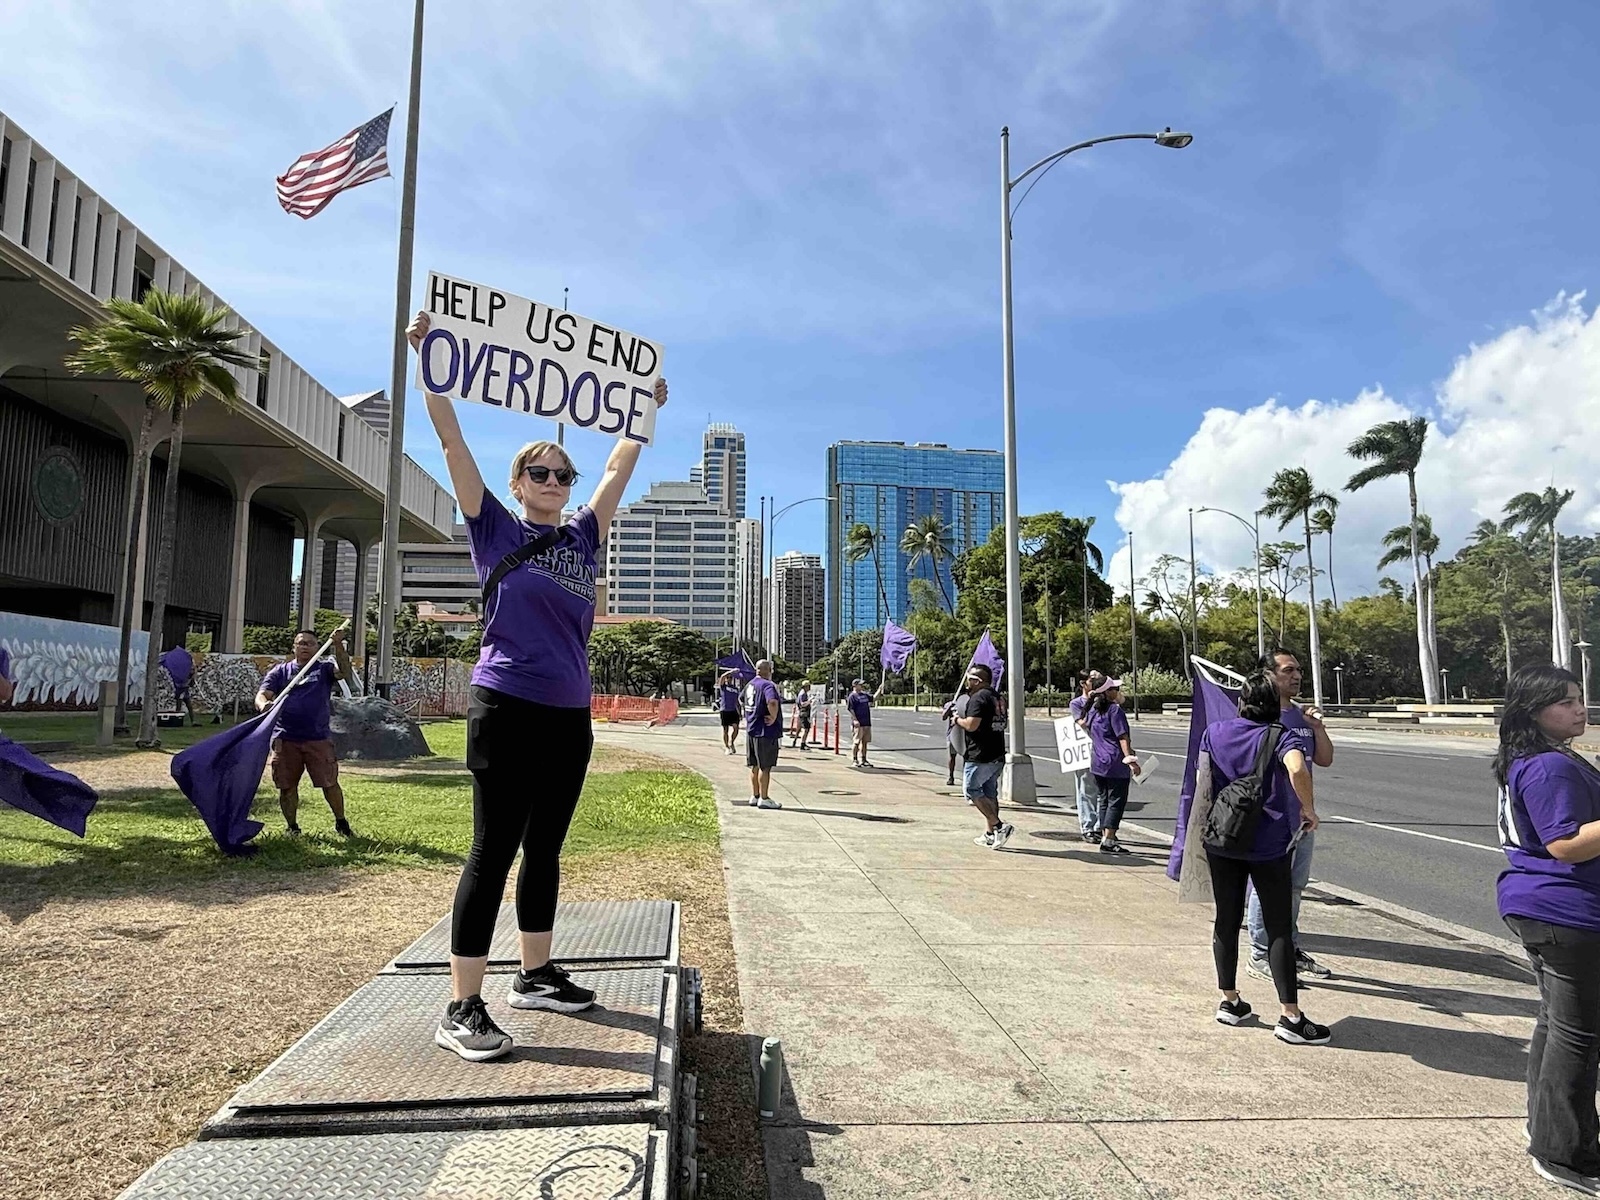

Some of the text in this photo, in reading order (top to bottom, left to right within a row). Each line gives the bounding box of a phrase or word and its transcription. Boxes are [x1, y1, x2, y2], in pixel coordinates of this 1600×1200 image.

[430, 275, 658, 378] HELP US END
[421, 328, 653, 444] OVERDOSE
[1073, 722, 1086, 741] E
